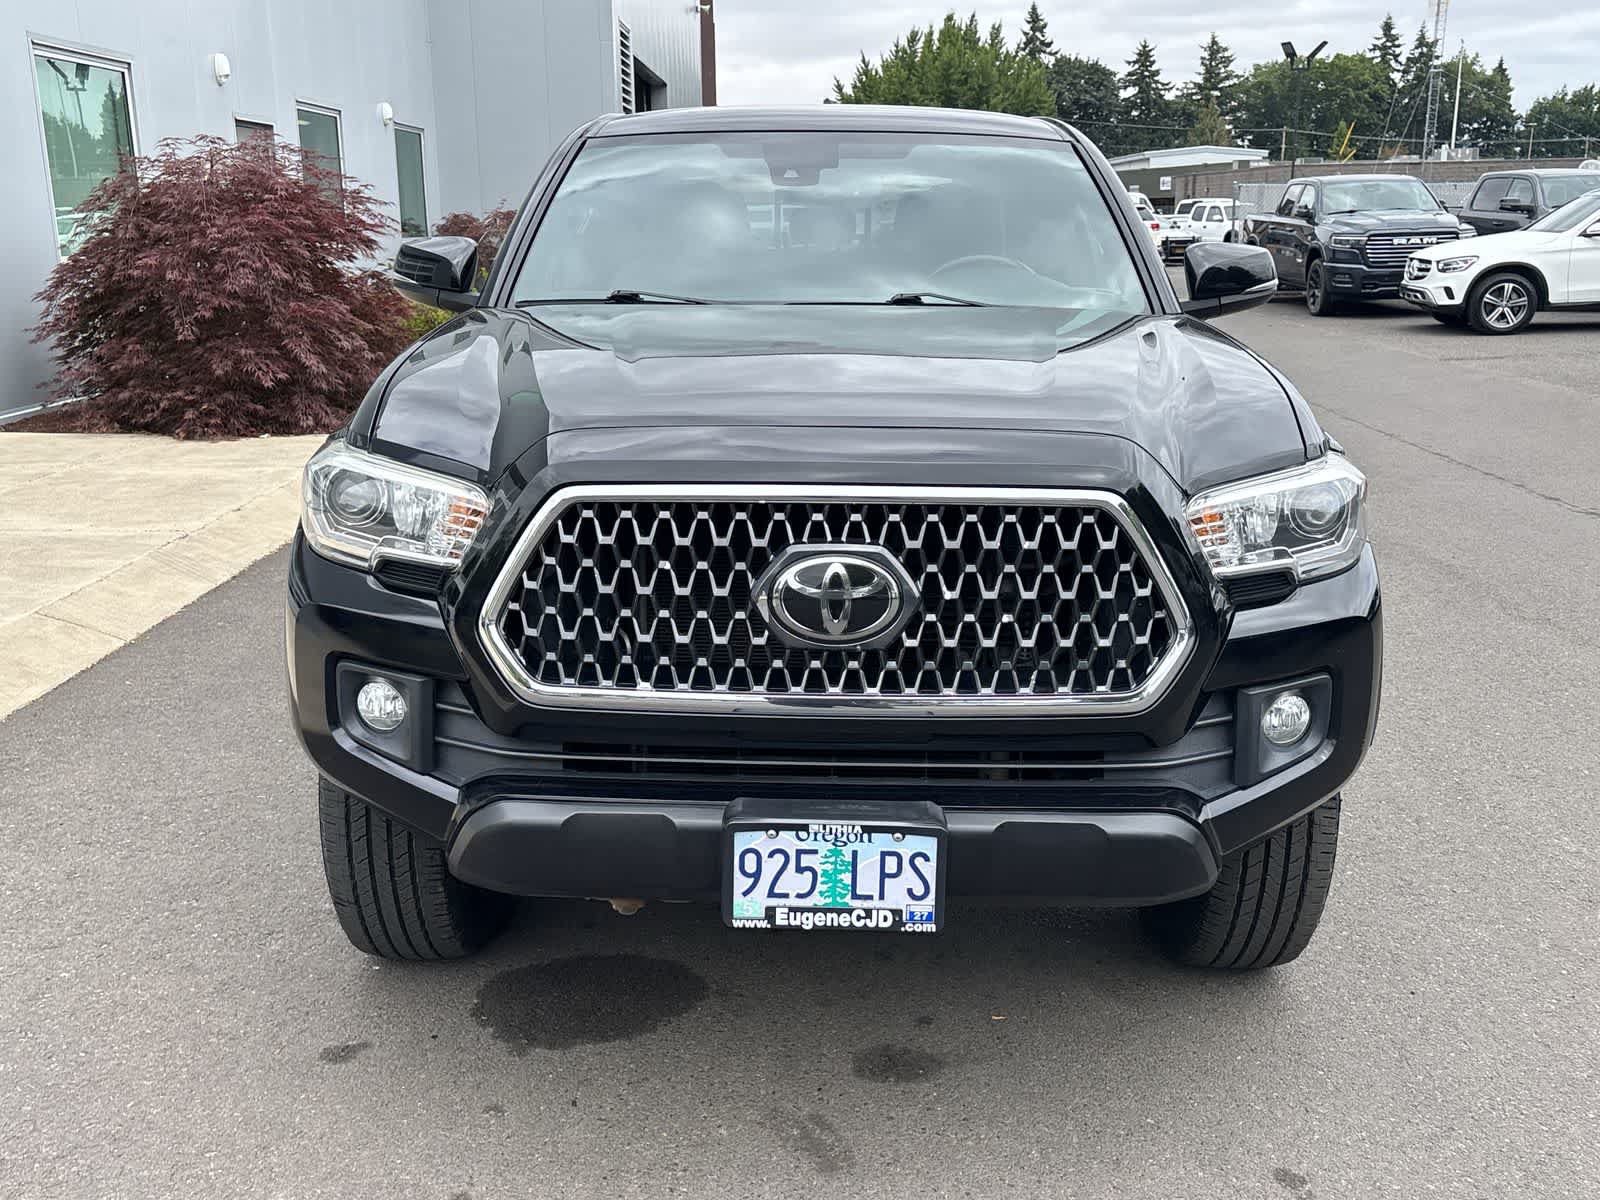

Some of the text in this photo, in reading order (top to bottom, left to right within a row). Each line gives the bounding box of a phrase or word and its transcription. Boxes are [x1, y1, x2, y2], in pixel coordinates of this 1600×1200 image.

[1393, 237, 1438, 245] RAM
[820, 824, 863, 834] LITHIA
[738, 847, 931, 902] 925 LPS
[732, 907, 937, 933] www. EugeneCJD .com
[913, 911, 929, 921] 27
